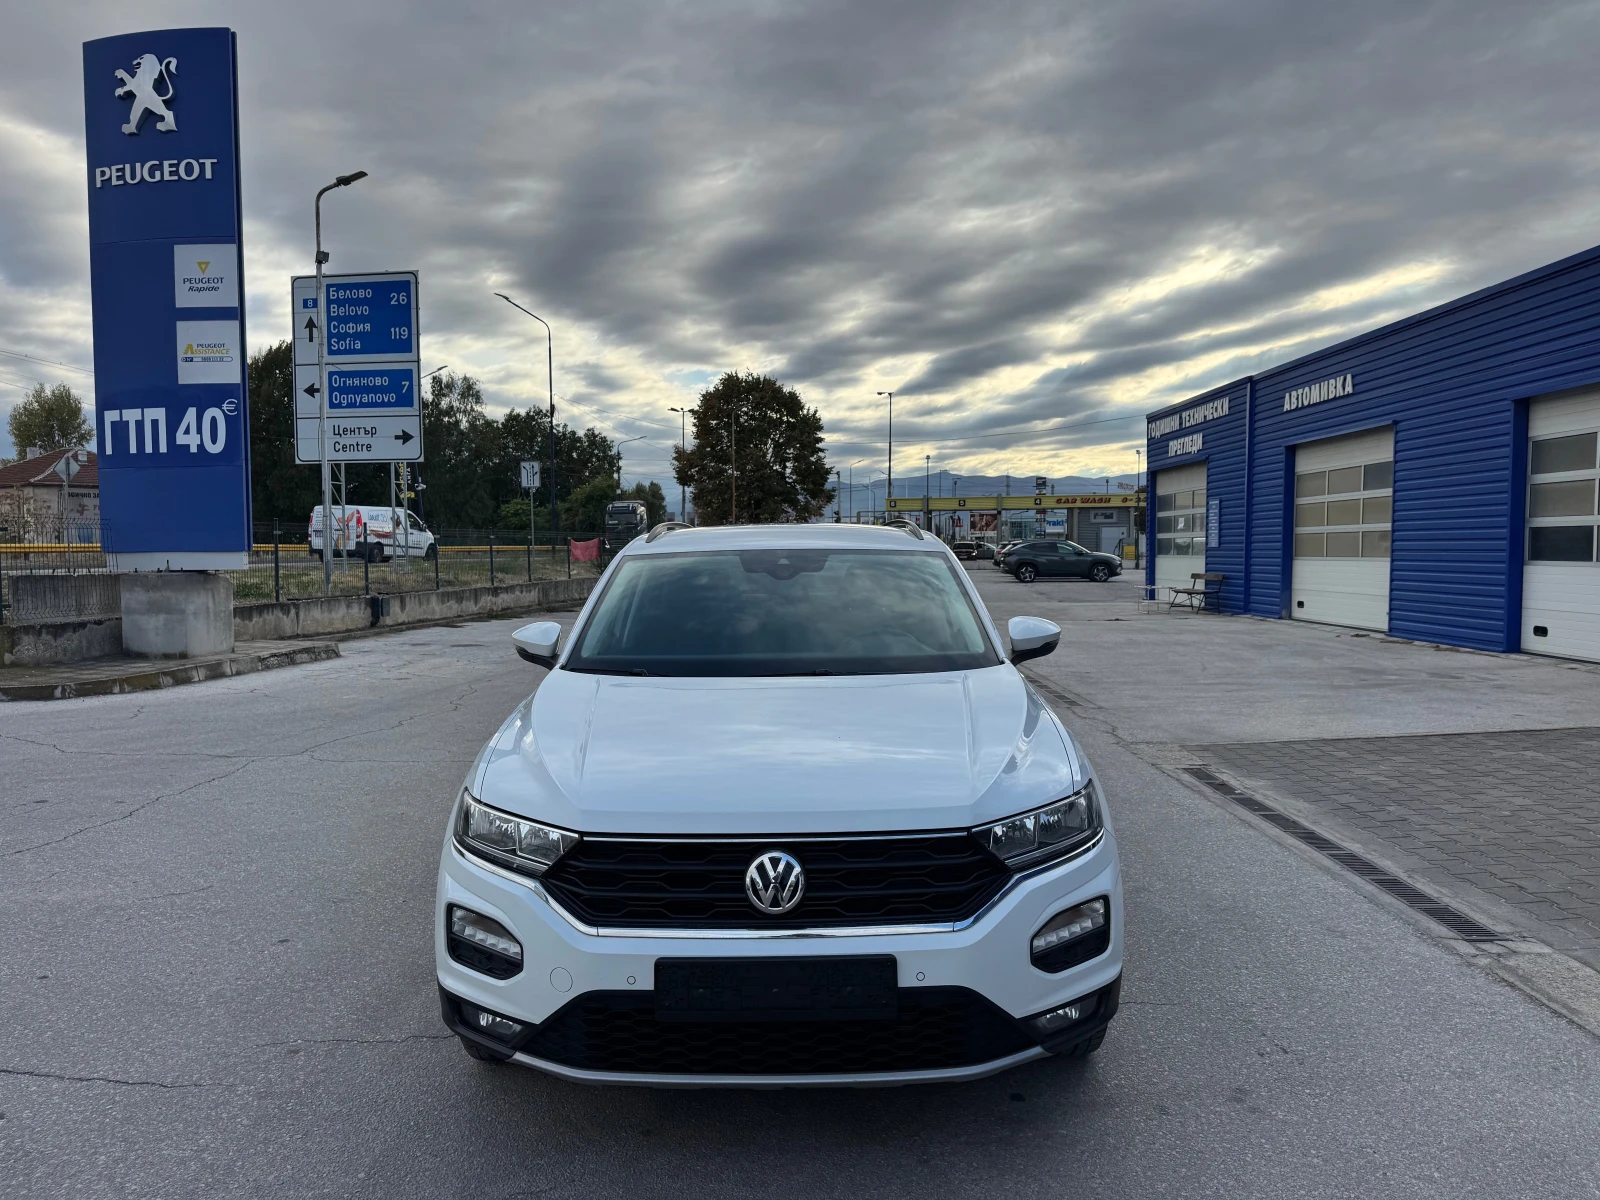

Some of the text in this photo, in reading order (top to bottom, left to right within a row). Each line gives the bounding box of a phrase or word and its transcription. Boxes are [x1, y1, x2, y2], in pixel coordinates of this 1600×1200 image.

[95, 158, 218, 188] PEUGEOT
[187, 285, 220, 293] Rapide
[329, 287, 408, 305] Белово 26
[307, 300, 313, 308] 8
[330, 304, 369, 316] Belovo
[330, 321, 409, 340] София 119
[331, 338, 361, 350] Sofia
[331, 375, 410, 394] Огняново 7
[1283, 373, 1354, 412] АВТОМИВКА
[332, 392, 396, 406] Ognyanovo
[1148, 396, 1229, 439] ГОДИШНИ ТЕХНИЧЕСКИ
[103, 407, 168, 455] ГТП
[333, 424, 377, 438] Център
[333, 440, 372, 453] Centre
[1168, 432, 1203, 457] ПРЕГЛЕДИ
